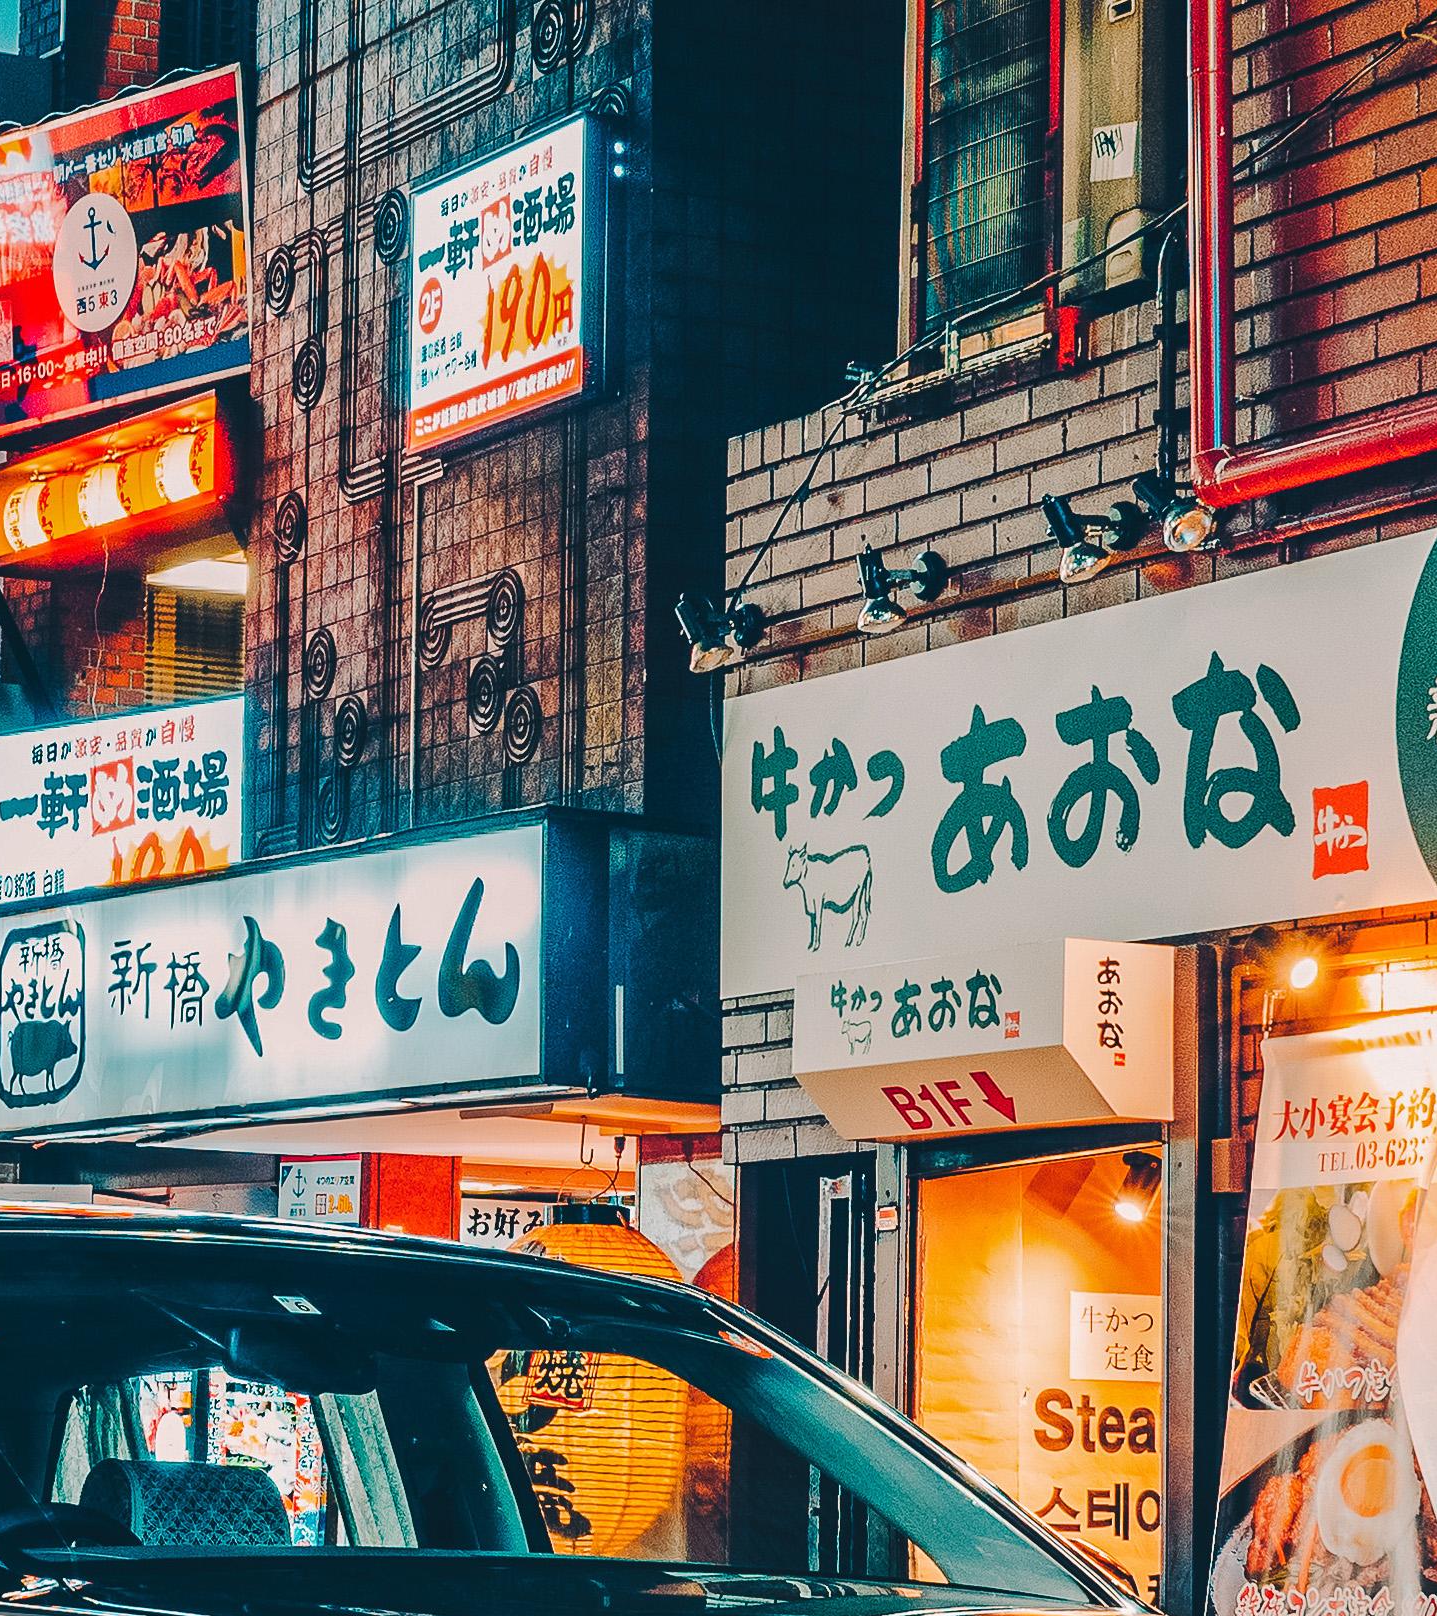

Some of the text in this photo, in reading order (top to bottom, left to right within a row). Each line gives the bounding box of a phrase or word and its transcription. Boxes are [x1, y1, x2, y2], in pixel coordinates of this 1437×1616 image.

[481, 252, 575, 370] 190円
[749, 724, 905, 842] 牛かつ
[931, 651, 1302, 895] あおな
[829, 979, 883, 1018] 牛かつ
[890, 968, 1003, 1039] あおな
[1096, 956, 1124, 1050] あおな
[880, 1079, 974, 1131] B1F
[1079, 1304, 1155, 1335] 牛かつ
[1103, 1342, 1155, 1372] 定食
